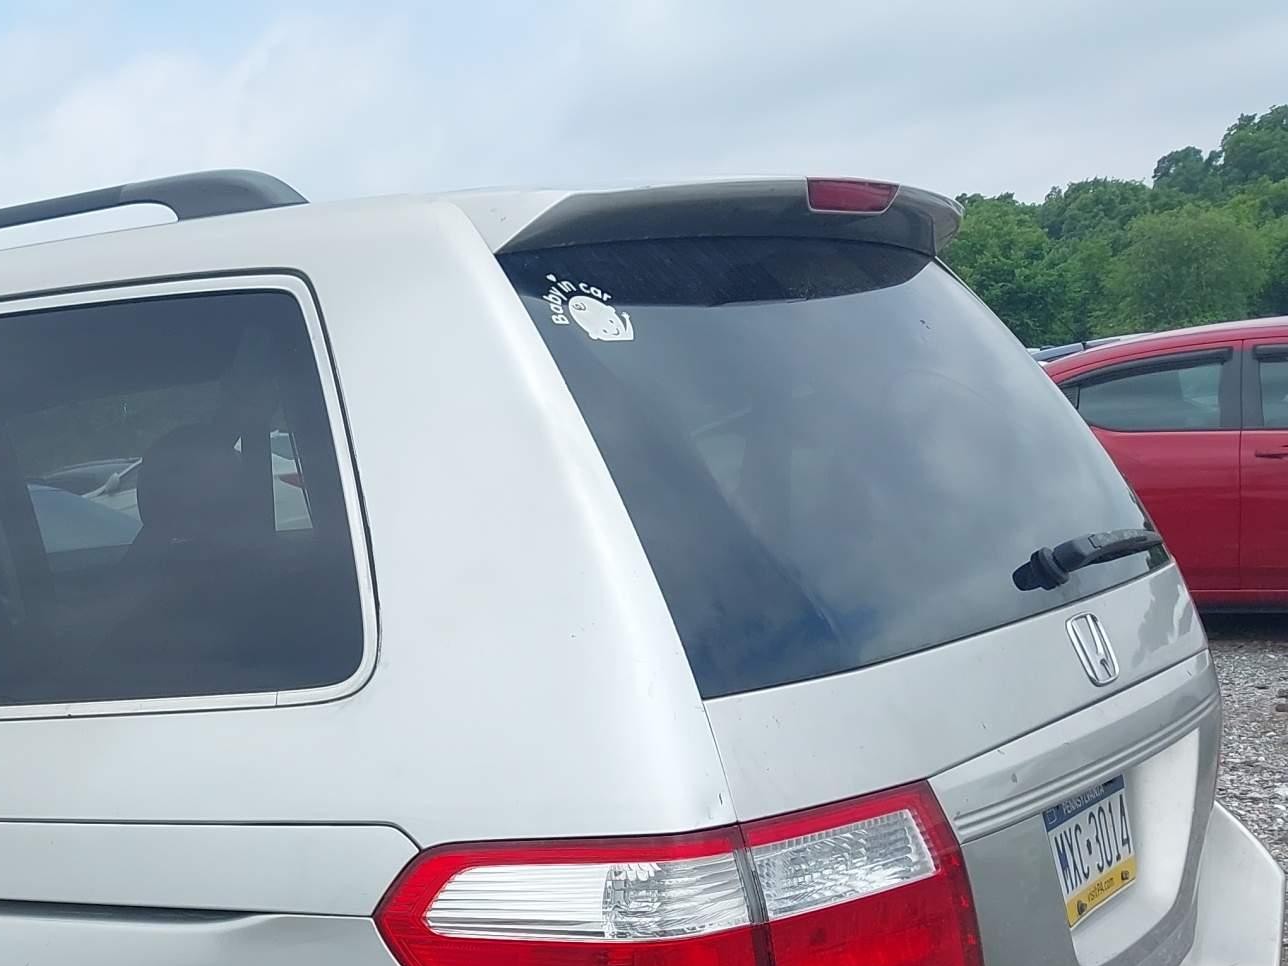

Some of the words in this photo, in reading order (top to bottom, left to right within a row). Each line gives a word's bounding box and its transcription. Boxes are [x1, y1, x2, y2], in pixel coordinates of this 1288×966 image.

[546, 274, 577, 293] in
[578, 282, 612, 302] car
[542, 286, 570, 325] Baby
